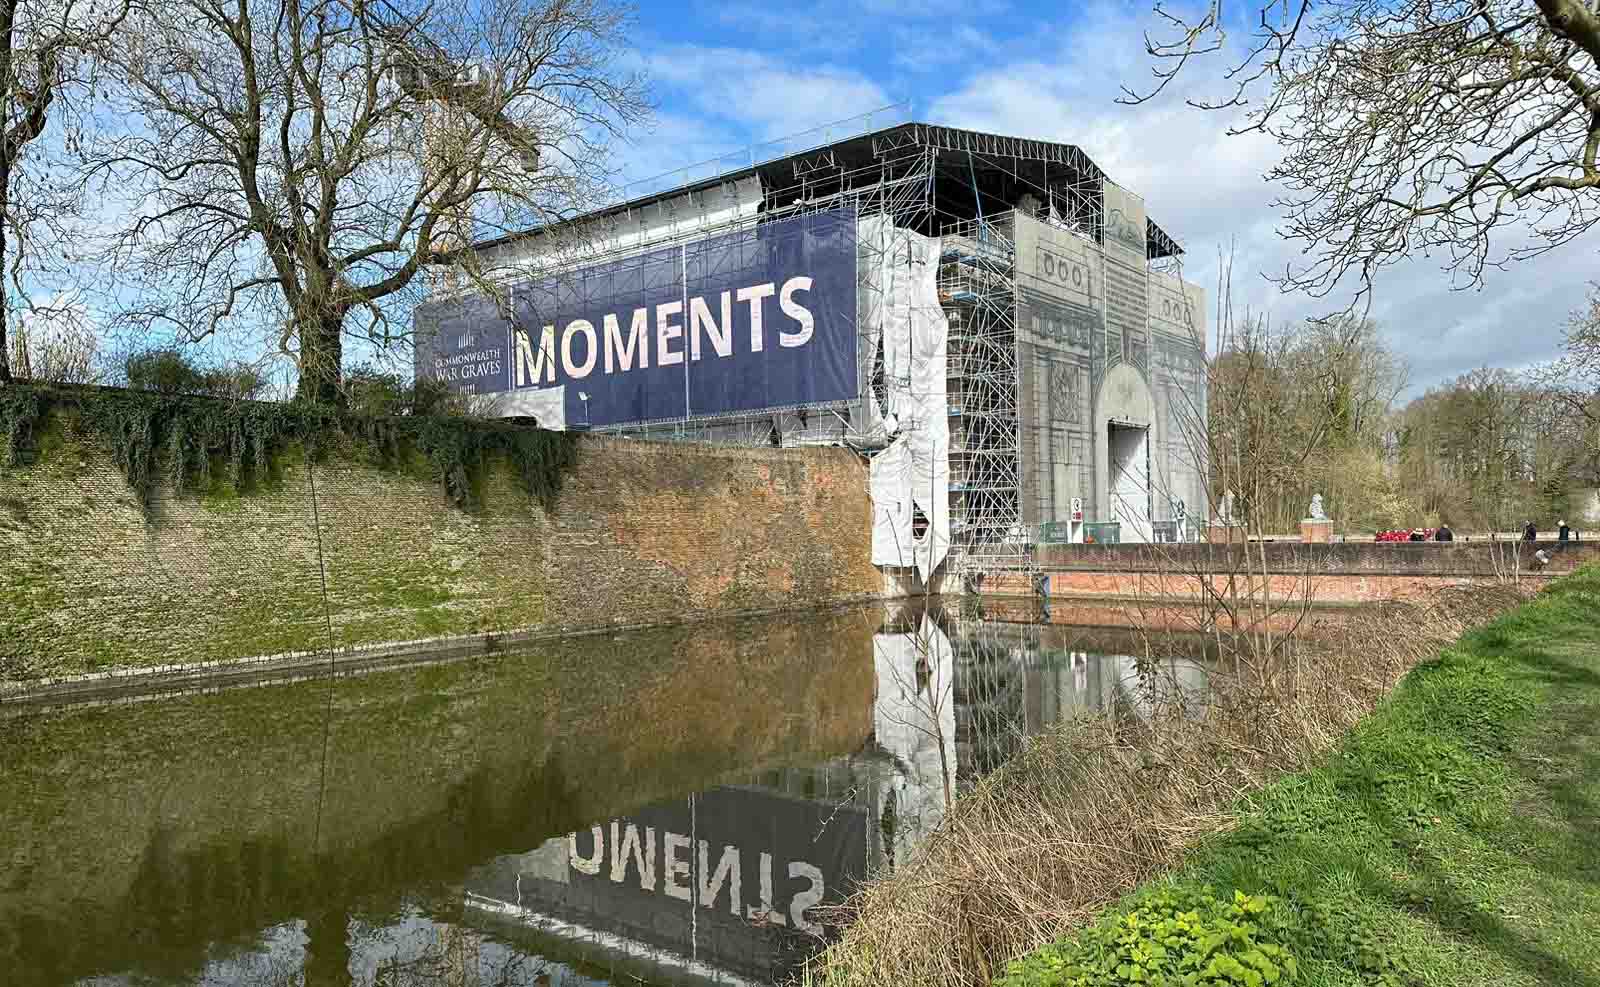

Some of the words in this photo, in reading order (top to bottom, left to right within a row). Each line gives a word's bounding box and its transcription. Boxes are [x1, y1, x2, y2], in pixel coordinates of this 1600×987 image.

[515, 276, 815, 386] MOMENTS
[434, 348, 500, 368] COMMONWEALTH
[435, 367, 458, 382] WAR
[461, 360, 501, 379] GRAVES
